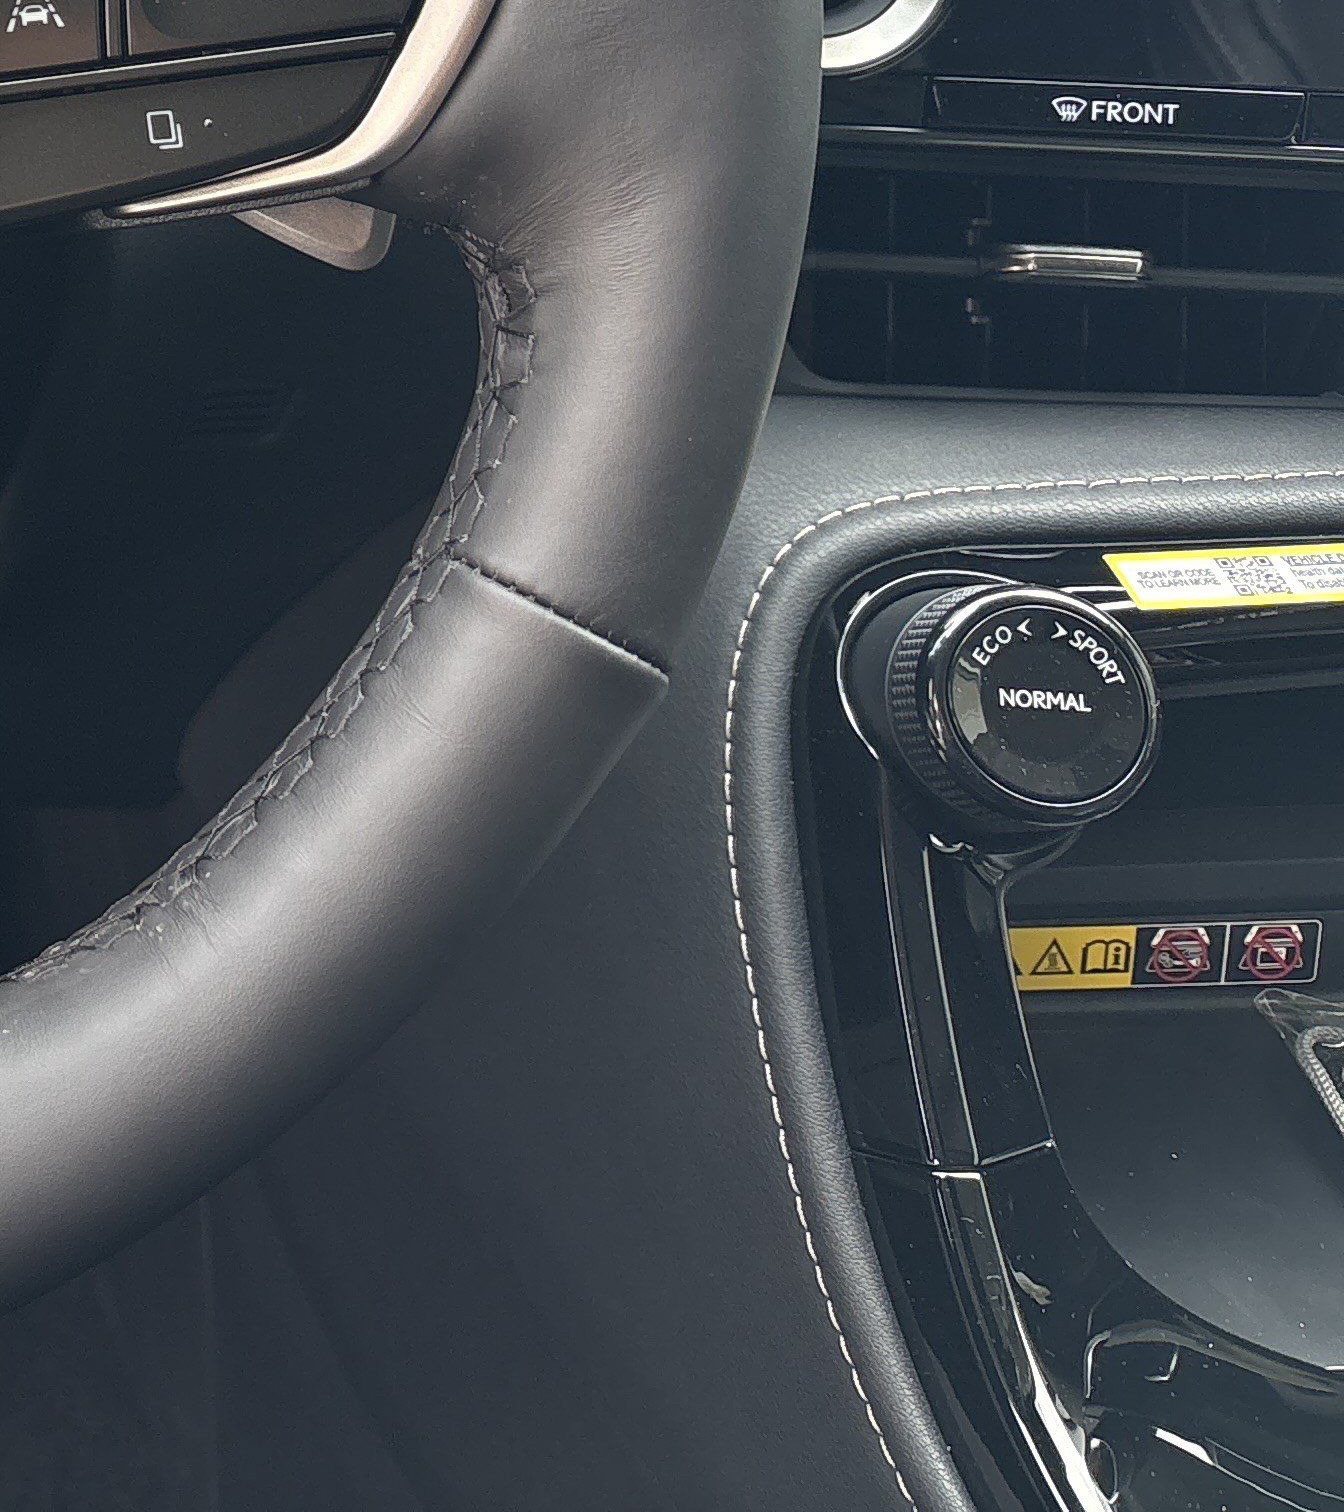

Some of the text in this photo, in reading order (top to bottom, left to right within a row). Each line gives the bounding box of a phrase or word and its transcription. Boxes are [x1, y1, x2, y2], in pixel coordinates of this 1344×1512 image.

[1090, 100, 1180, 125] FRONT
[971, 624, 1014, 668] ECO
[1068, 628, 1127, 686] SPORT
[998, 687, 1093, 713] NORMAL
